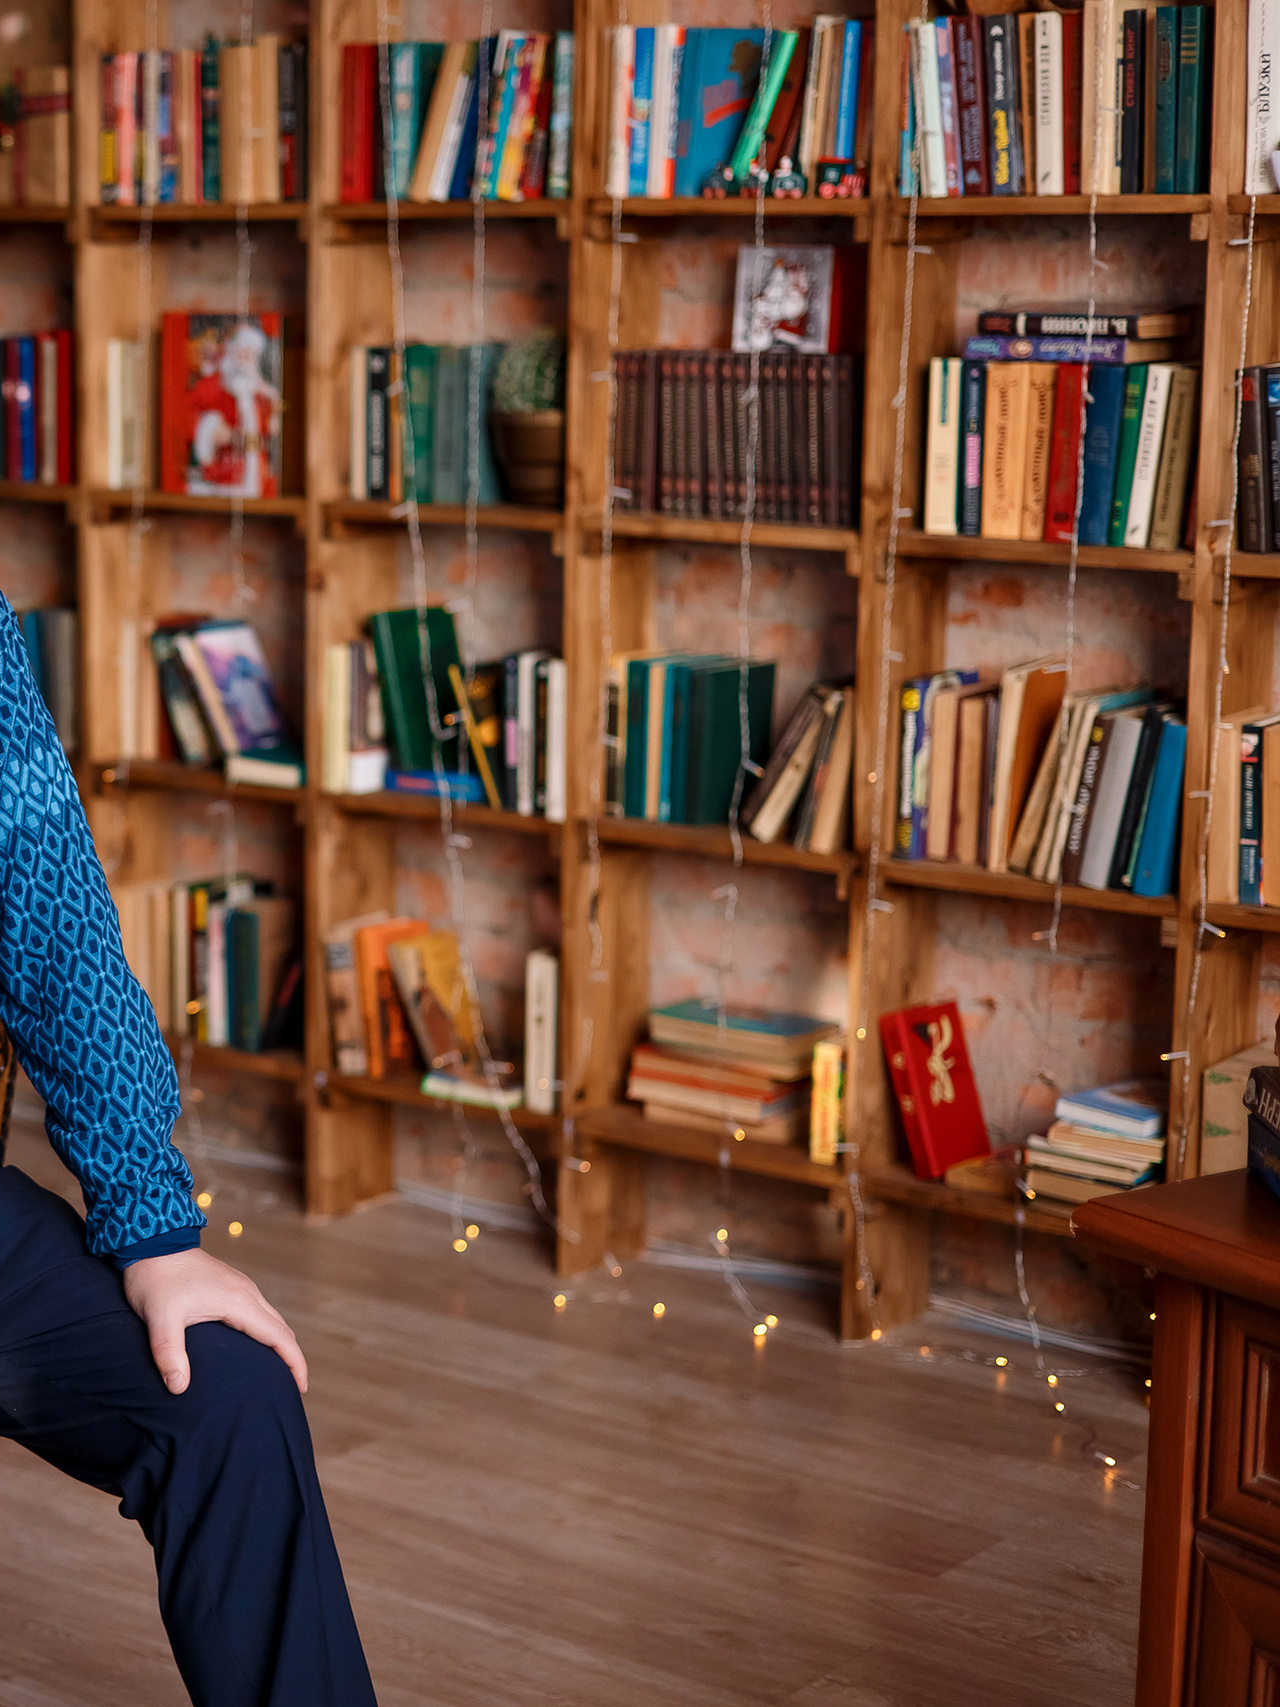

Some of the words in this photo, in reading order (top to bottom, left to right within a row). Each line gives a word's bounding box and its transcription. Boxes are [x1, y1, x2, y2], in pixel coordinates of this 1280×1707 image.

[1127, 28, 1135, 59] КИНГ
[1126, 63, 1135, 107] СТИВЕН
[1259, 53, 1271, 113] БЛУЗКИ
[1257, 1087, 1280, 1132] ЕРН
